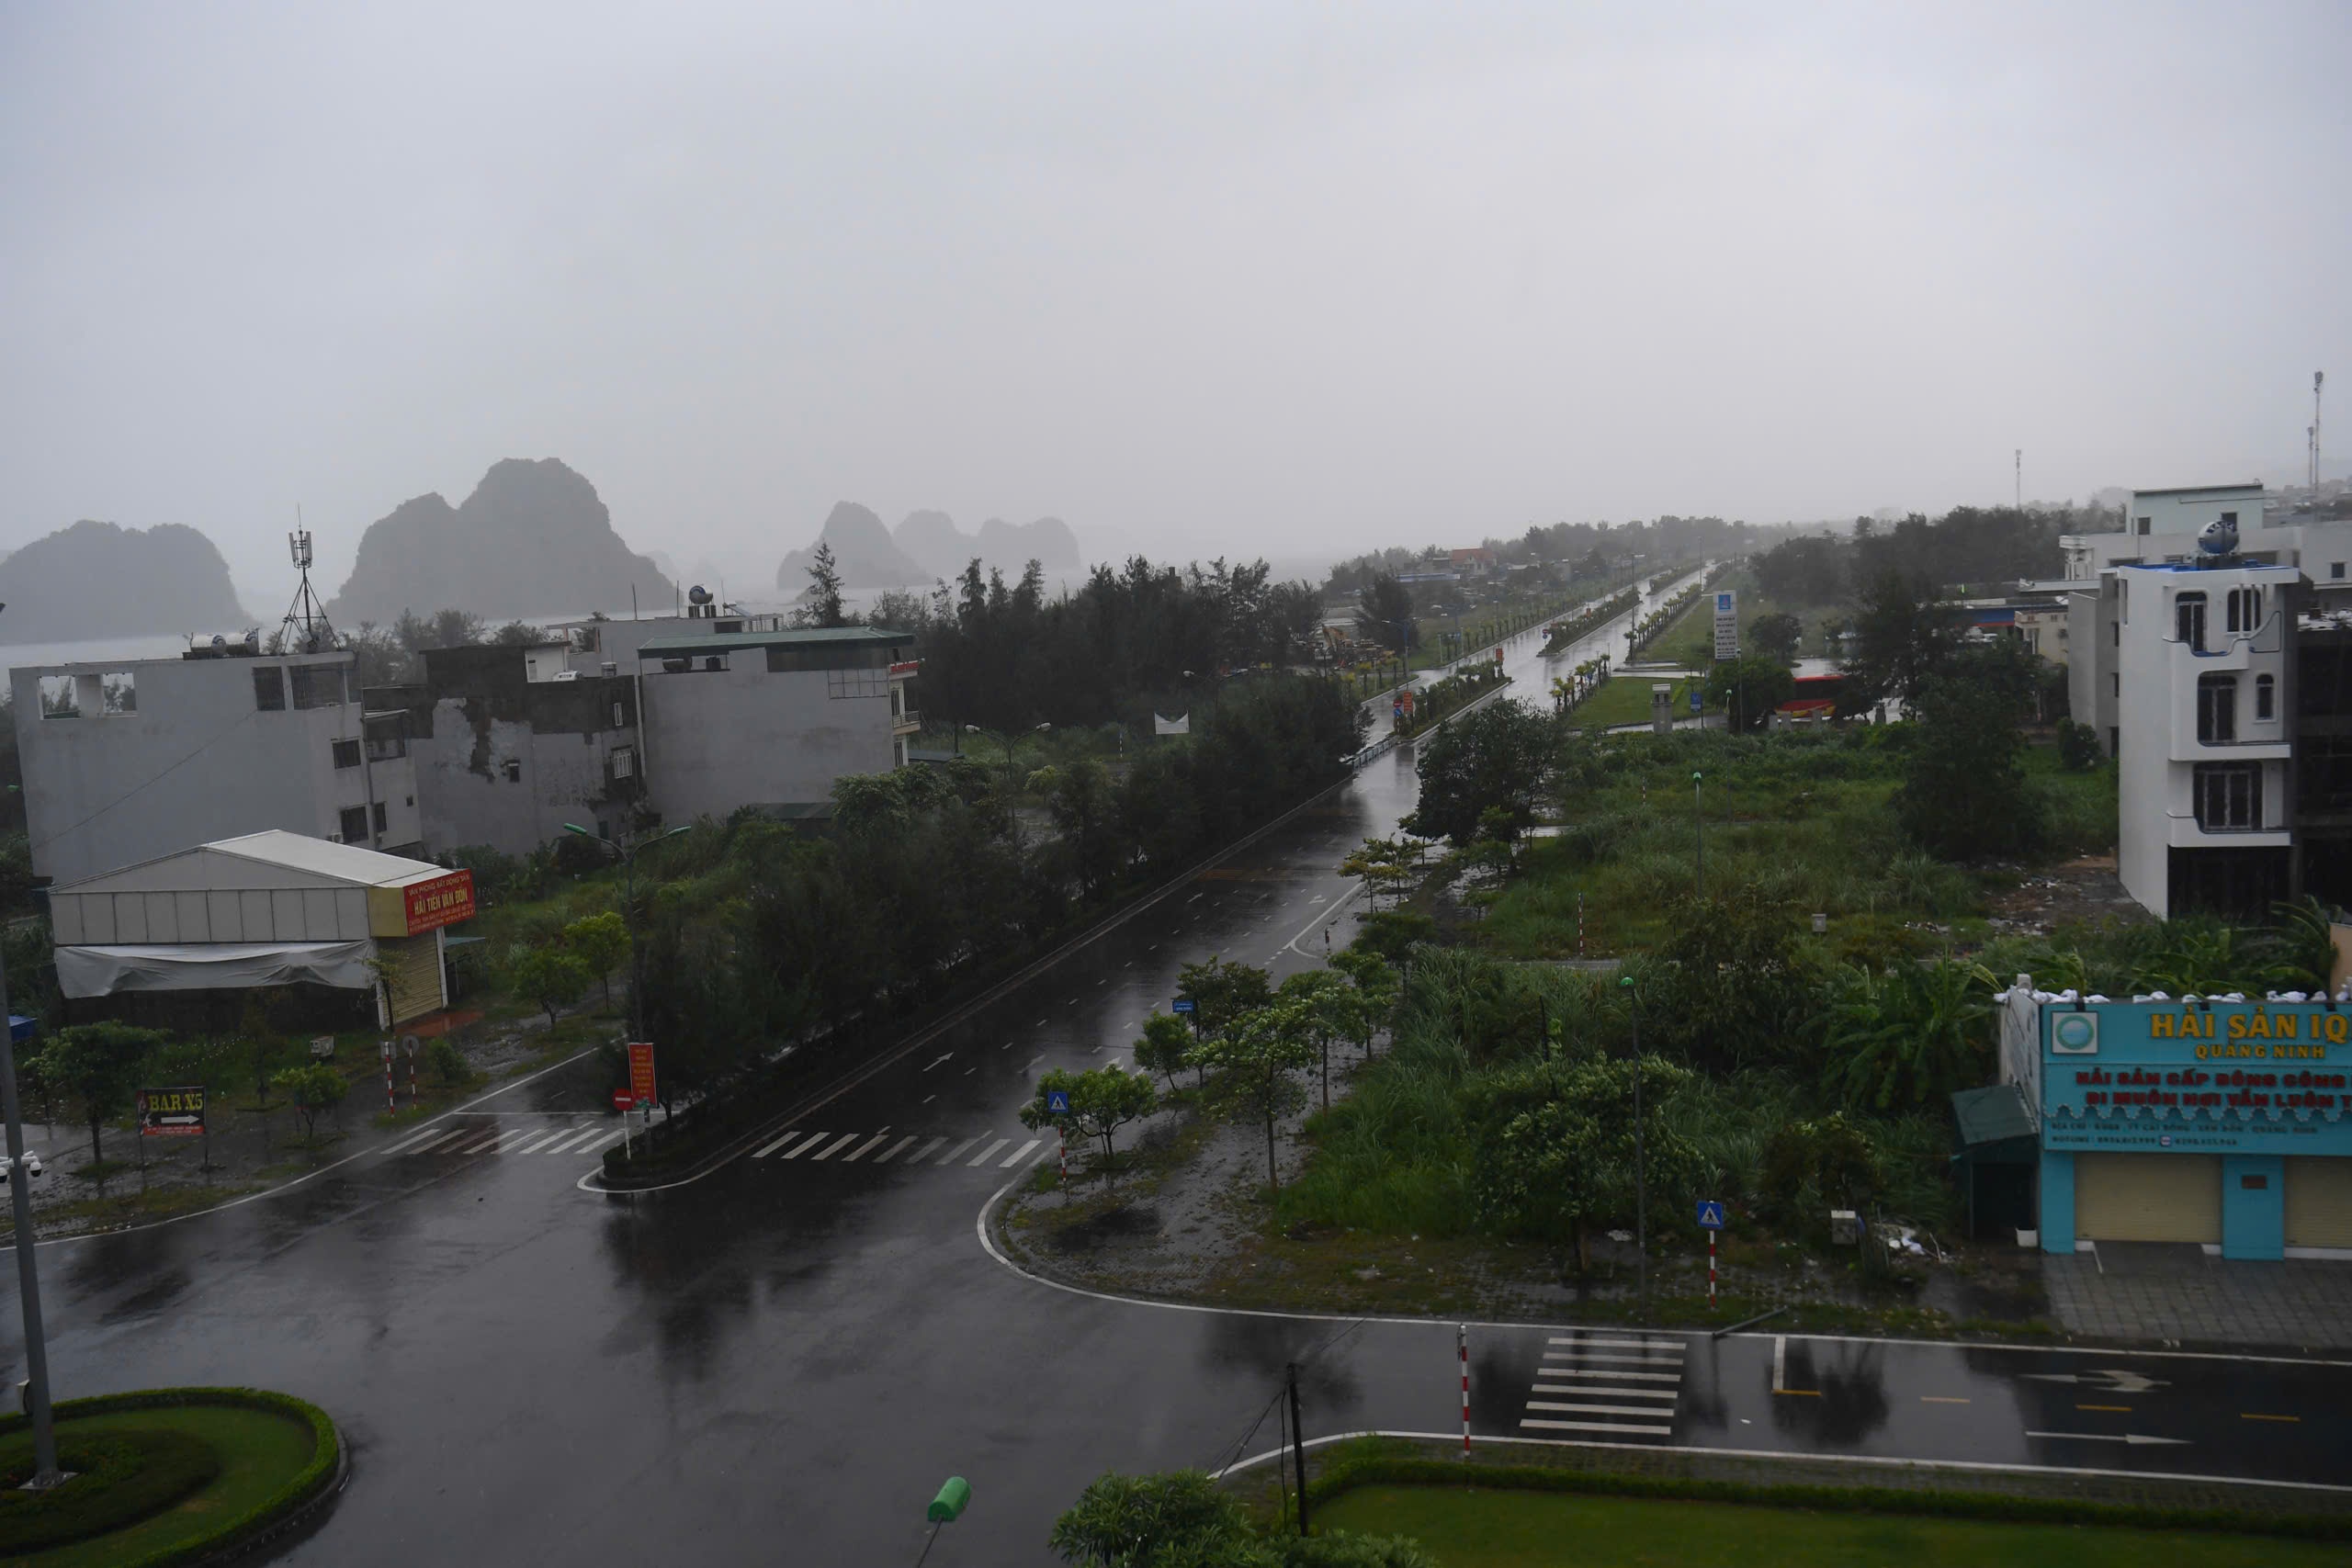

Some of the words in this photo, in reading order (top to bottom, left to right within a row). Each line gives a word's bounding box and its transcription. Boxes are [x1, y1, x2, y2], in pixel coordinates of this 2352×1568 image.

[413, 895, 426, 916] HẢI
[426, 891, 441, 912] TIẾN
[2151, 1005, 2215, 1038] HẢI
[2228, 1006, 2297, 1039] SẢN
[2310, 1014, 2352, 1043] IQ
[2195, 1039, 2267, 1060] QUẢNG
[2273, 1045, 2325, 1059] NINH
[2075, 1066, 2111, 1085] HẢI
[2118, 1066, 2161, 1085] SẢN
[2165, 1067, 2210, 1086] CẤP
[2215, 1069, 2276, 1088] ĐÔNG
[2283, 1070, 2346, 1089] CÔNG
[148, 1094, 182, 1111] BAR
[185, 1093, 203, 1111] X5
[2086, 1091, 2108, 1105] ĐI
[2112, 1088, 2177, 1106] MUÔN
[2226, 1088, 2269, 1107] VẪN
[2275, 1089, 2335, 1108] LUÔN
